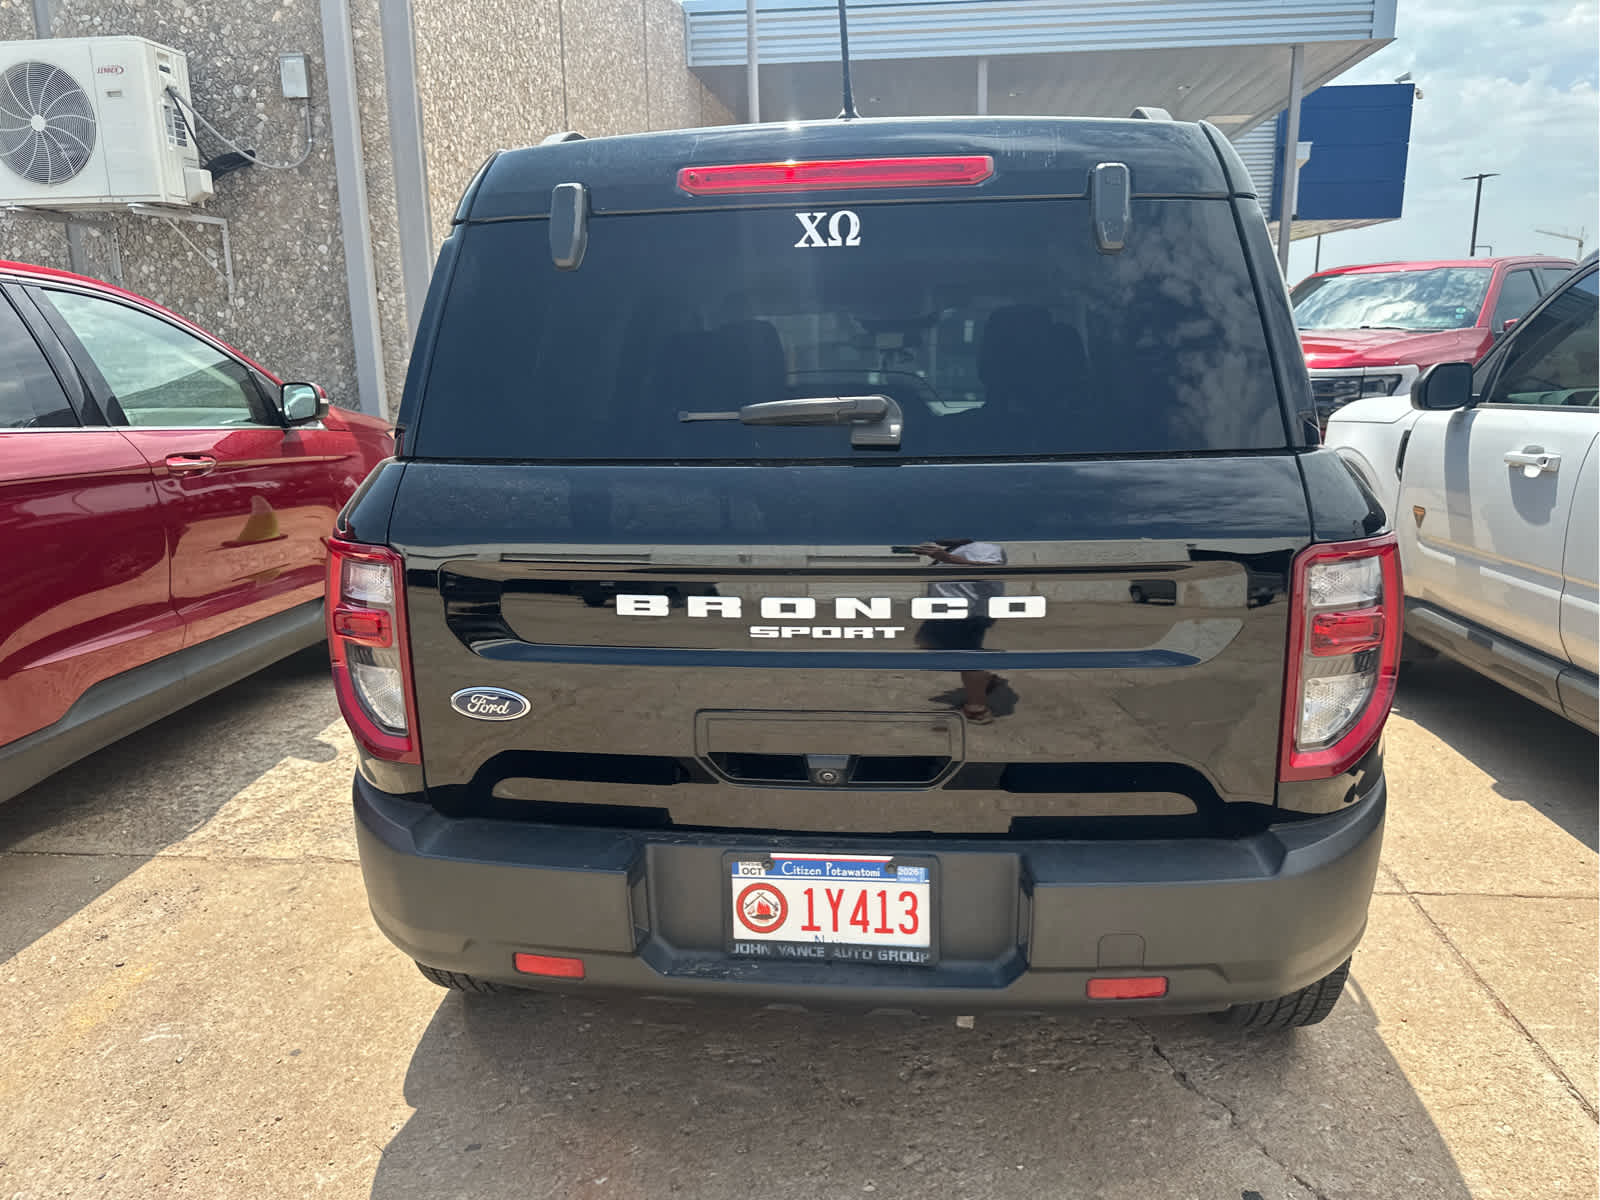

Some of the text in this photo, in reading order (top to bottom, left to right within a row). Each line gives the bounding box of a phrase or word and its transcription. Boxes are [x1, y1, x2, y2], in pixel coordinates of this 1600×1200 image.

[616, 594, 1046, 619] BRONCO
[749, 626, 905, 639] SPORT
[467, 694, 511, 714] Ford
[742, 867, 762, 875] OCT
[781, 861, 880, 877] Citizen Potawatomi
[801, 887, 919, 935] 1Y413
[733, 943, 929, 963] JOHN VANCE AUTO GROUP
